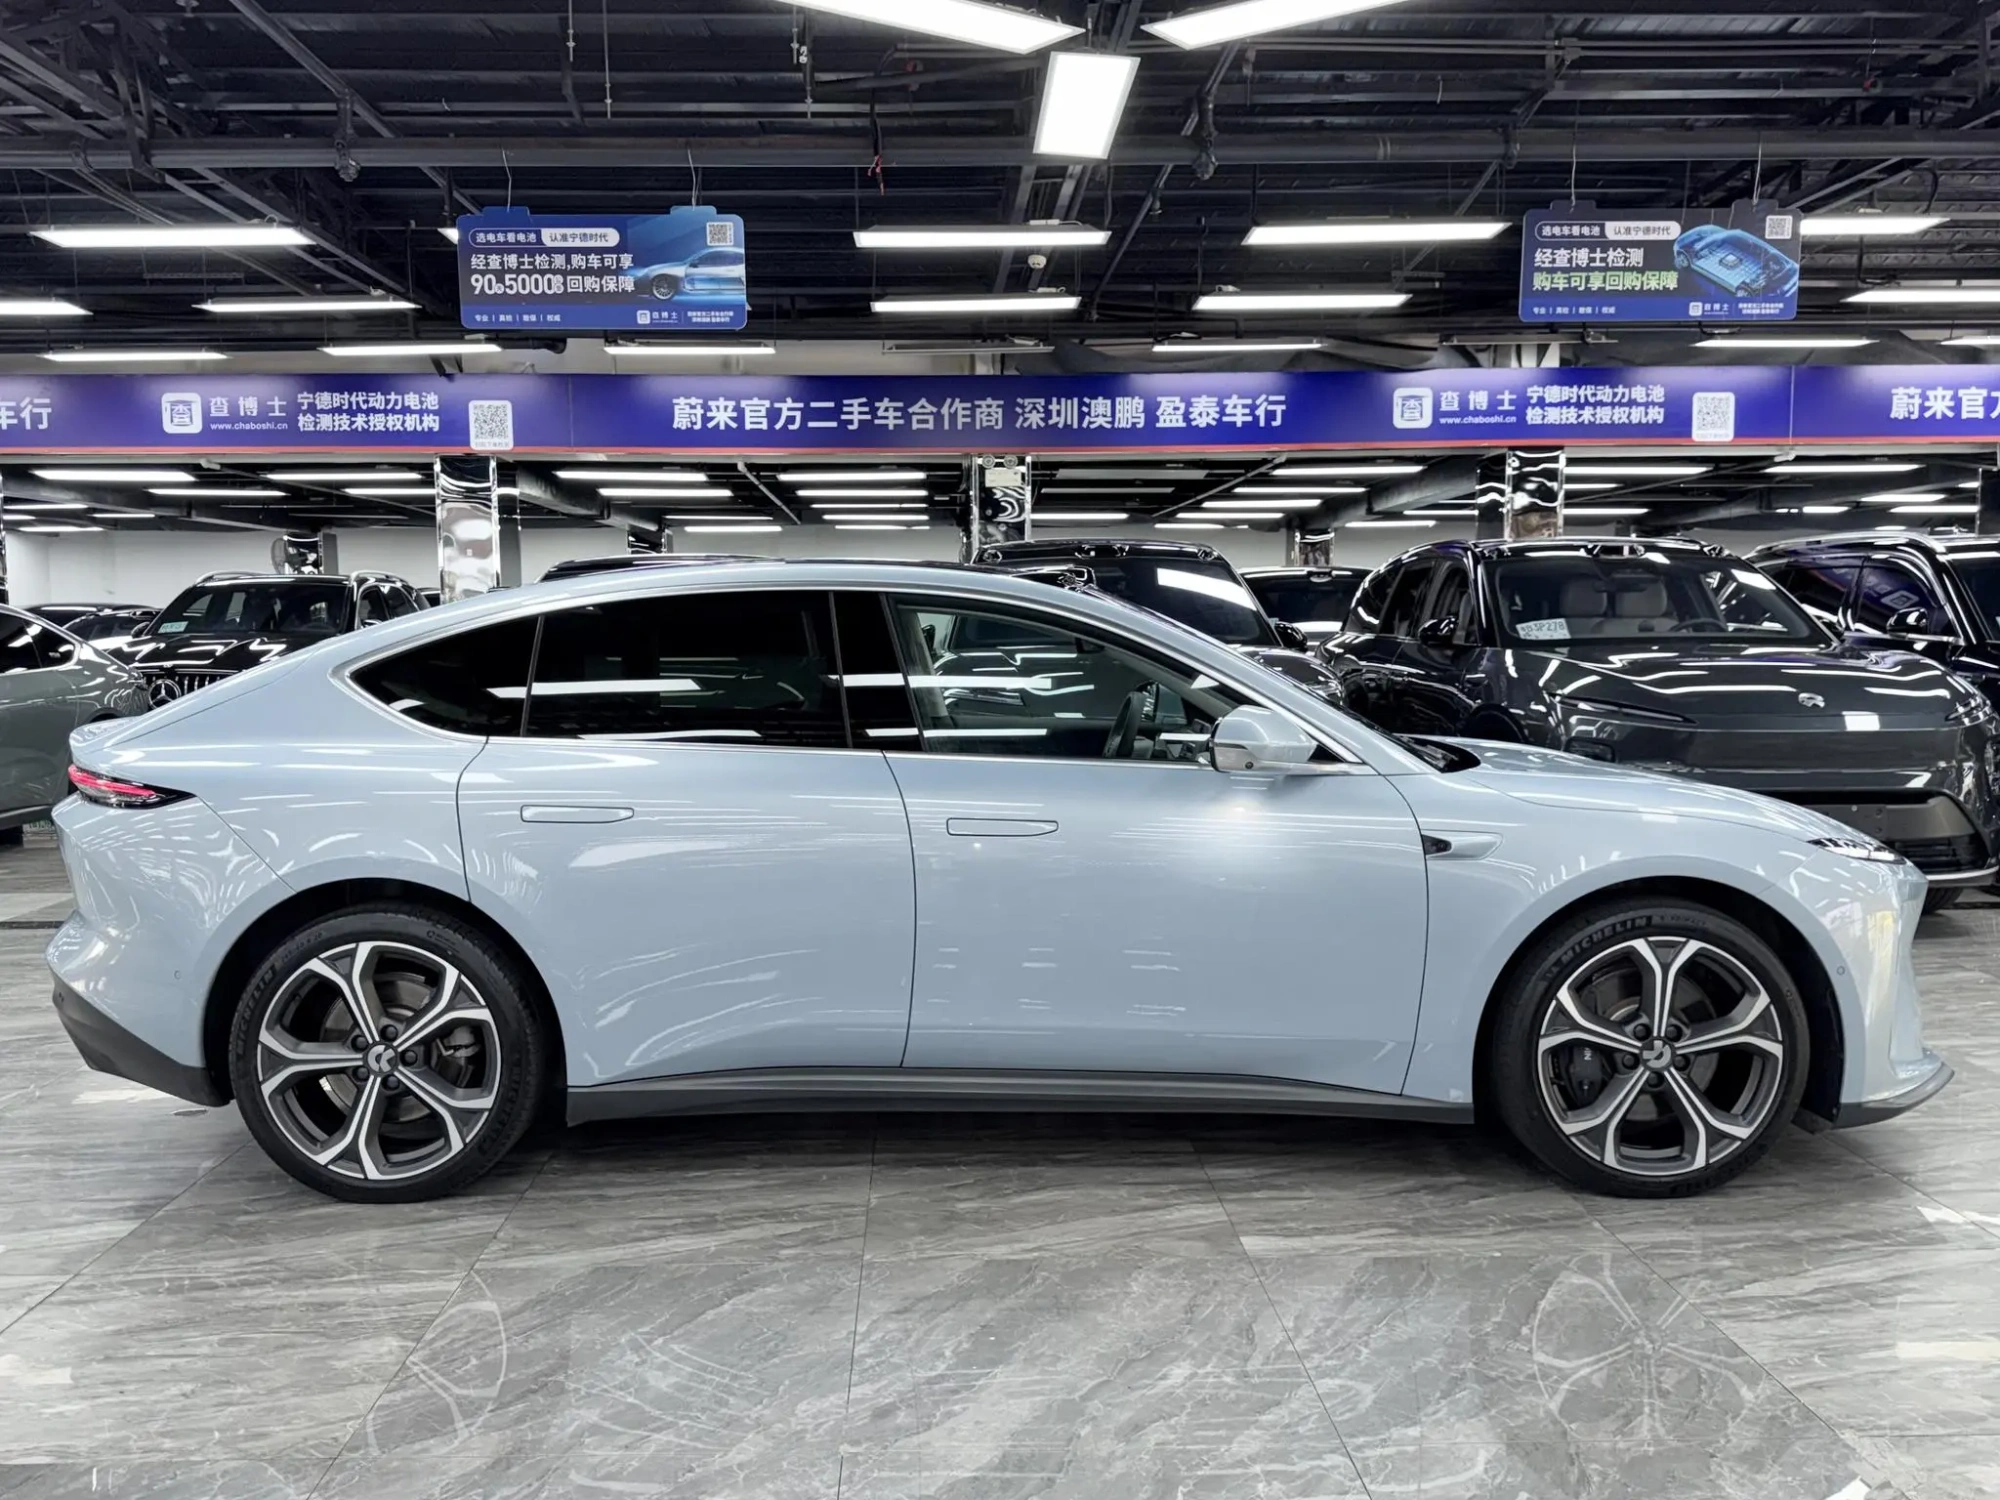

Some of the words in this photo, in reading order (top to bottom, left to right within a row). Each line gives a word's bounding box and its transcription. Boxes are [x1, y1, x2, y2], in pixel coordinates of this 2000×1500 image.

[475, 232, 536, 243] 选电车看电池
[549, 232, 609, 243] 认准宁德时代
[1541, 225, 1600, 236] 选电车看电池
[1613, 226, 1672, 236] 认准宁德时代
[1534, 248, 1644, 267] 经查博士检测
[1532, 271, 1678, 291] 购车可享回购保障
[297, 392, 439, 410] 宁德时代动力电池
[1439, 390, 1517, 411] 查博士
[1525, 385, 1665, 404] 宁德时代动力电池
[209, 396, 287, 417] 查博士
[672, 397, 1004, 430] 蔚来官方二手车合作商
[1015, 396, 1145, 429] 深圳澳鹏
[1155, 394, 1286, 428] 盈泰车行
[1525, 406, 1665, 425] 检测技术授权机构
[210, 421, 288, 431] www.chaboshi.cn
[297, 413, 439, 432] 检测技术授权机构
[1439, 414, 1517, 424] www.chaboshi.cn
[1561, 916, 1648, 964] MICHELIN
